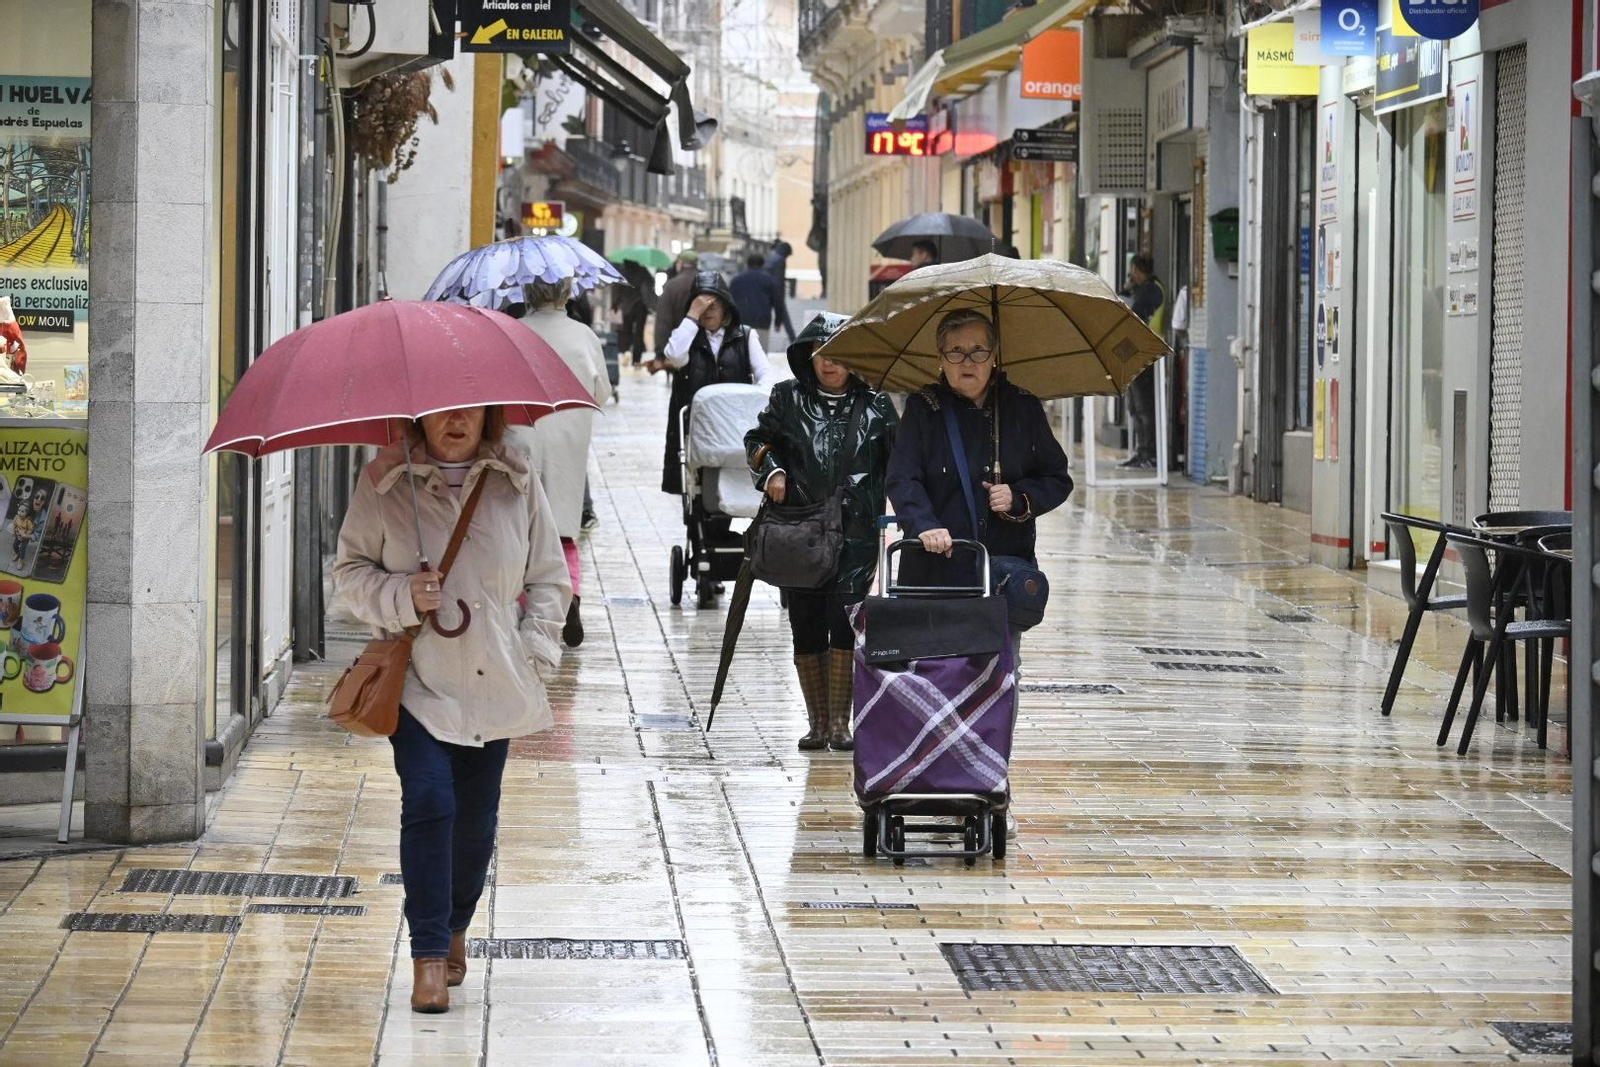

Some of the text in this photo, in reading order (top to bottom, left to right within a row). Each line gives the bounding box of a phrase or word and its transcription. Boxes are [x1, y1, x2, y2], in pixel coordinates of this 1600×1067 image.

[521, 2, 532, 10] en
[534, 0, 551, 12] piel
[506, 28, 563, 40] EN GALERIA
[9, 84, 92, 105] HUELVA
[1025, 81, 1082, 98] orange
[27, 107, 40, 116] de
[32, 117, 83, 131] Espuelas
[0, 275, 88, 291] enes exclusiva
[25, 294, 89, 310] personaliz
[38, 316, 70, 327] MOVIL
[0, 457, 66, 472] MENTO
